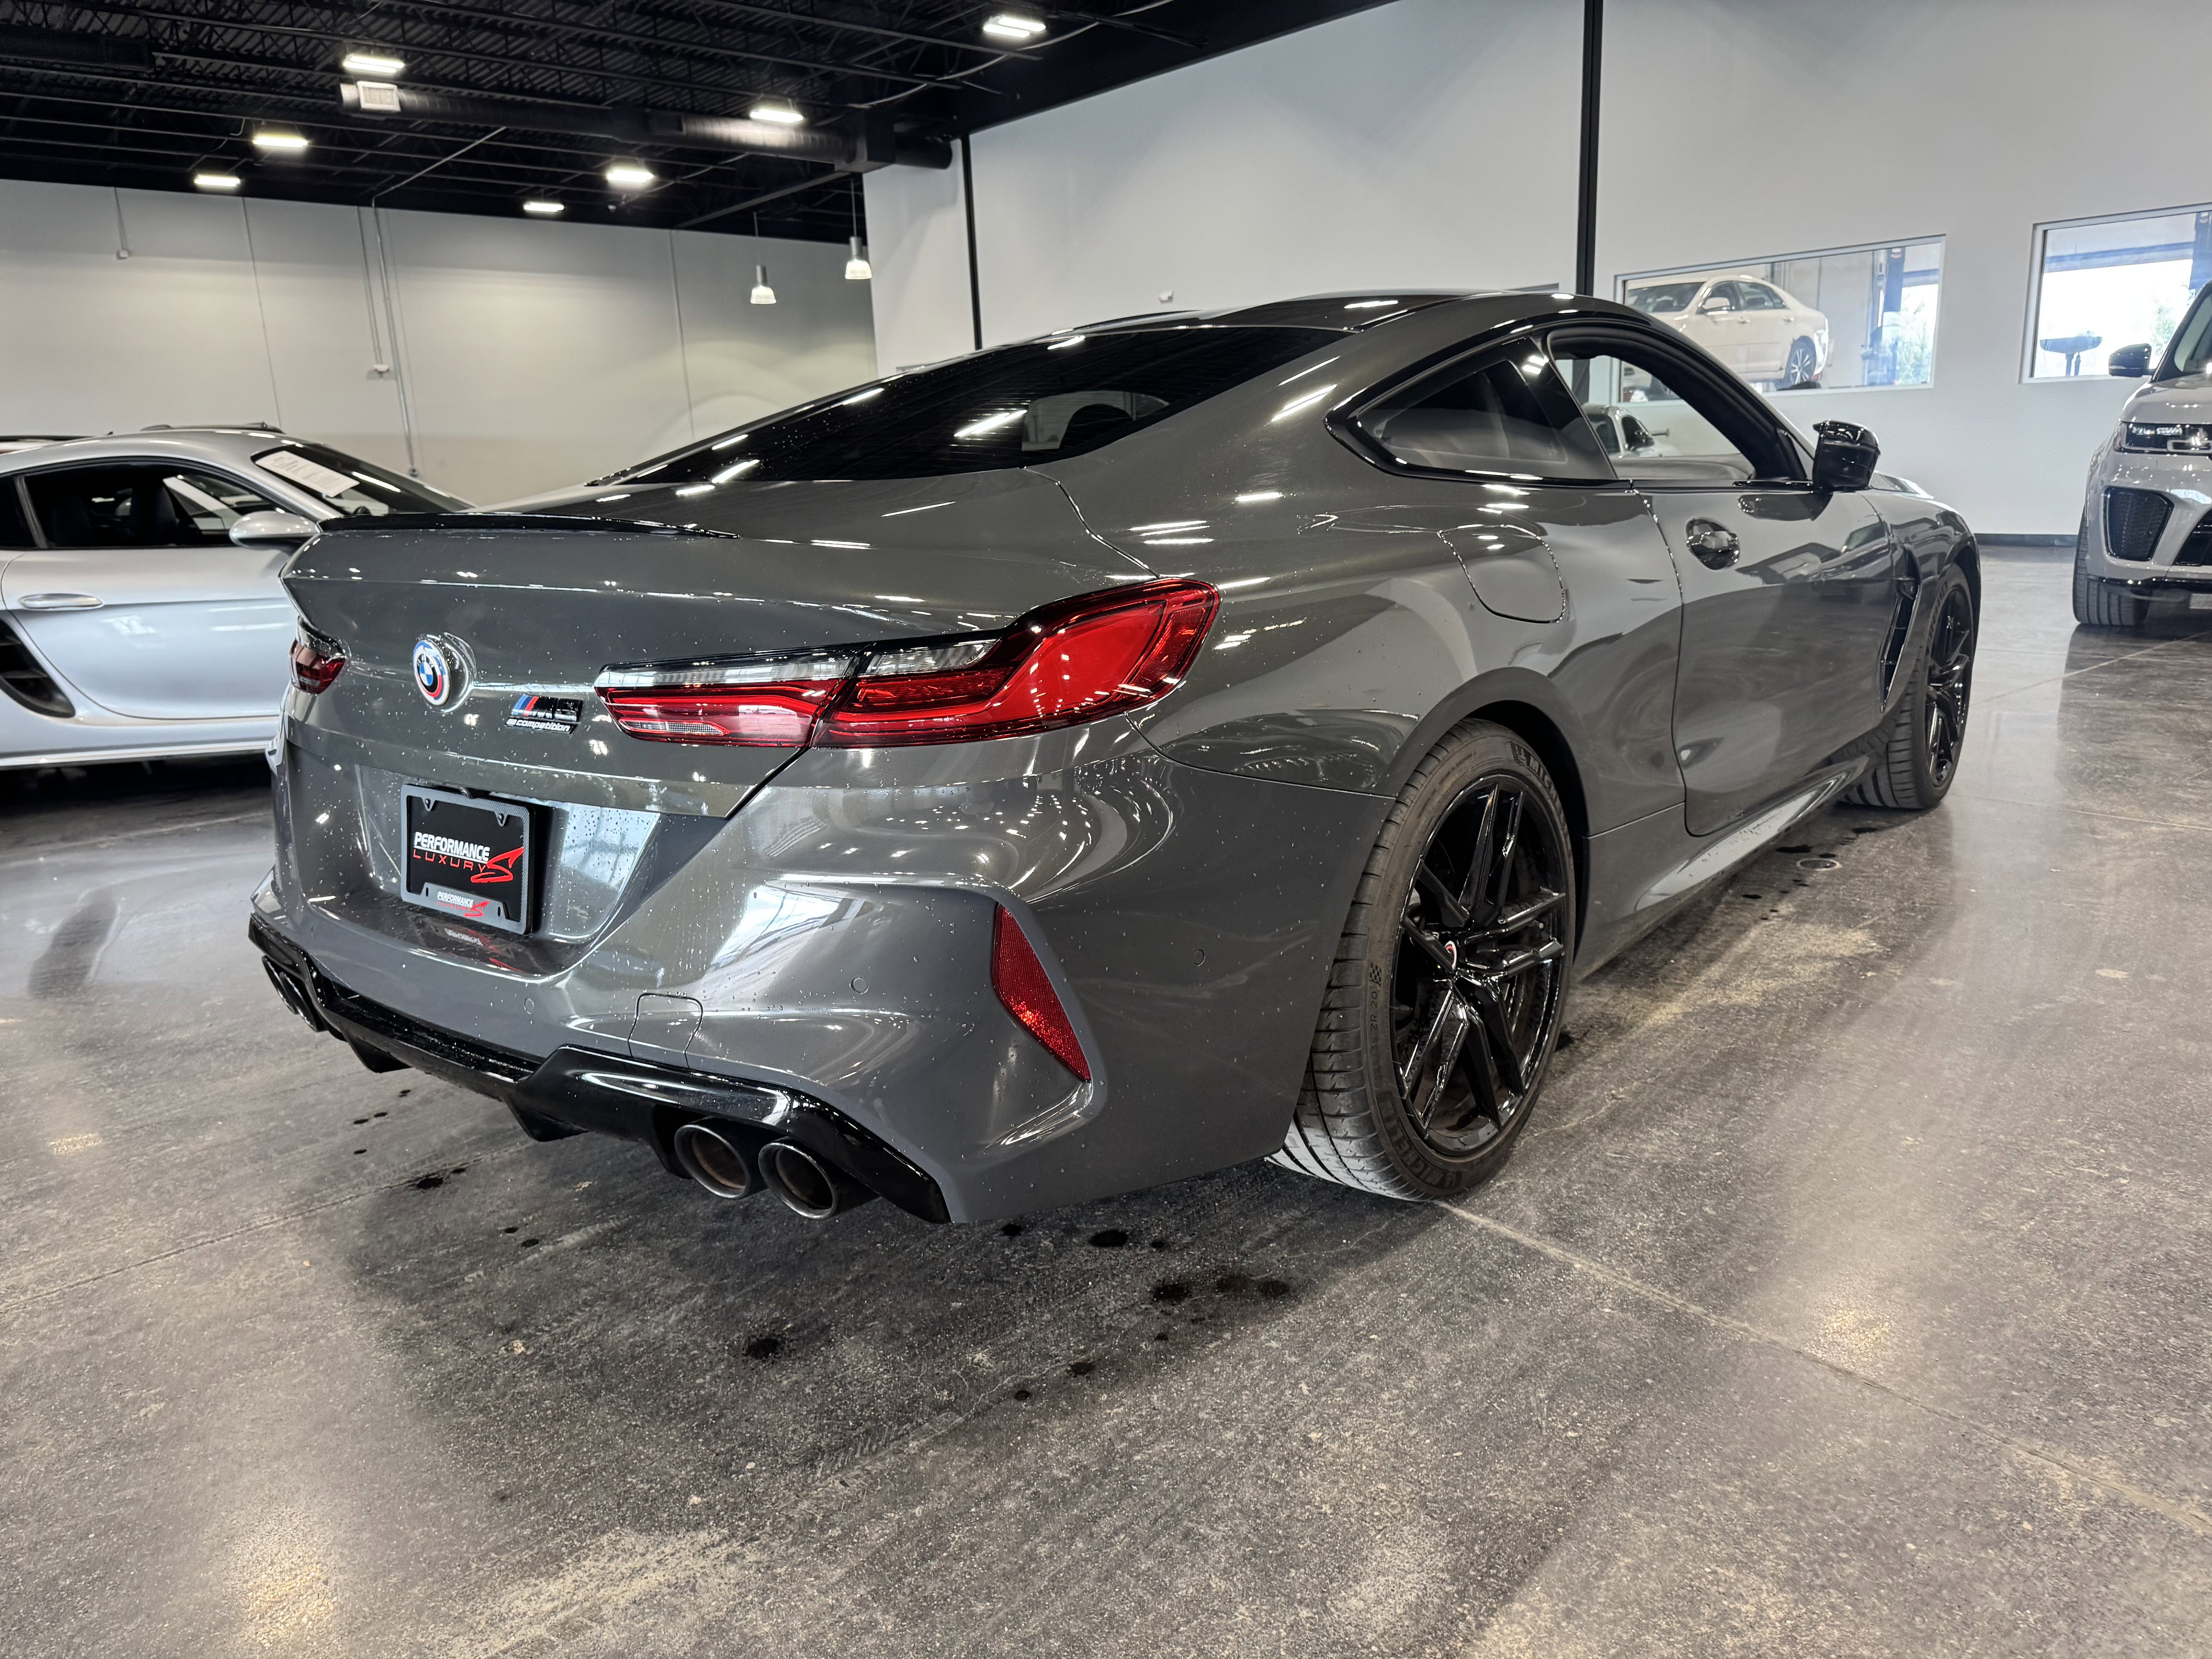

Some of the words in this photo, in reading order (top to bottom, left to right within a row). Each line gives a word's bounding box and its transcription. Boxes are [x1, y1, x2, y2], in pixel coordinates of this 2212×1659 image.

[516, 719, 571, 732] competition
[414, 831, 490, 862] PERFORMANCE
[413, 848, 486, 873] LUXURY
[437, 891, 474, 907] PERFORMANCE
